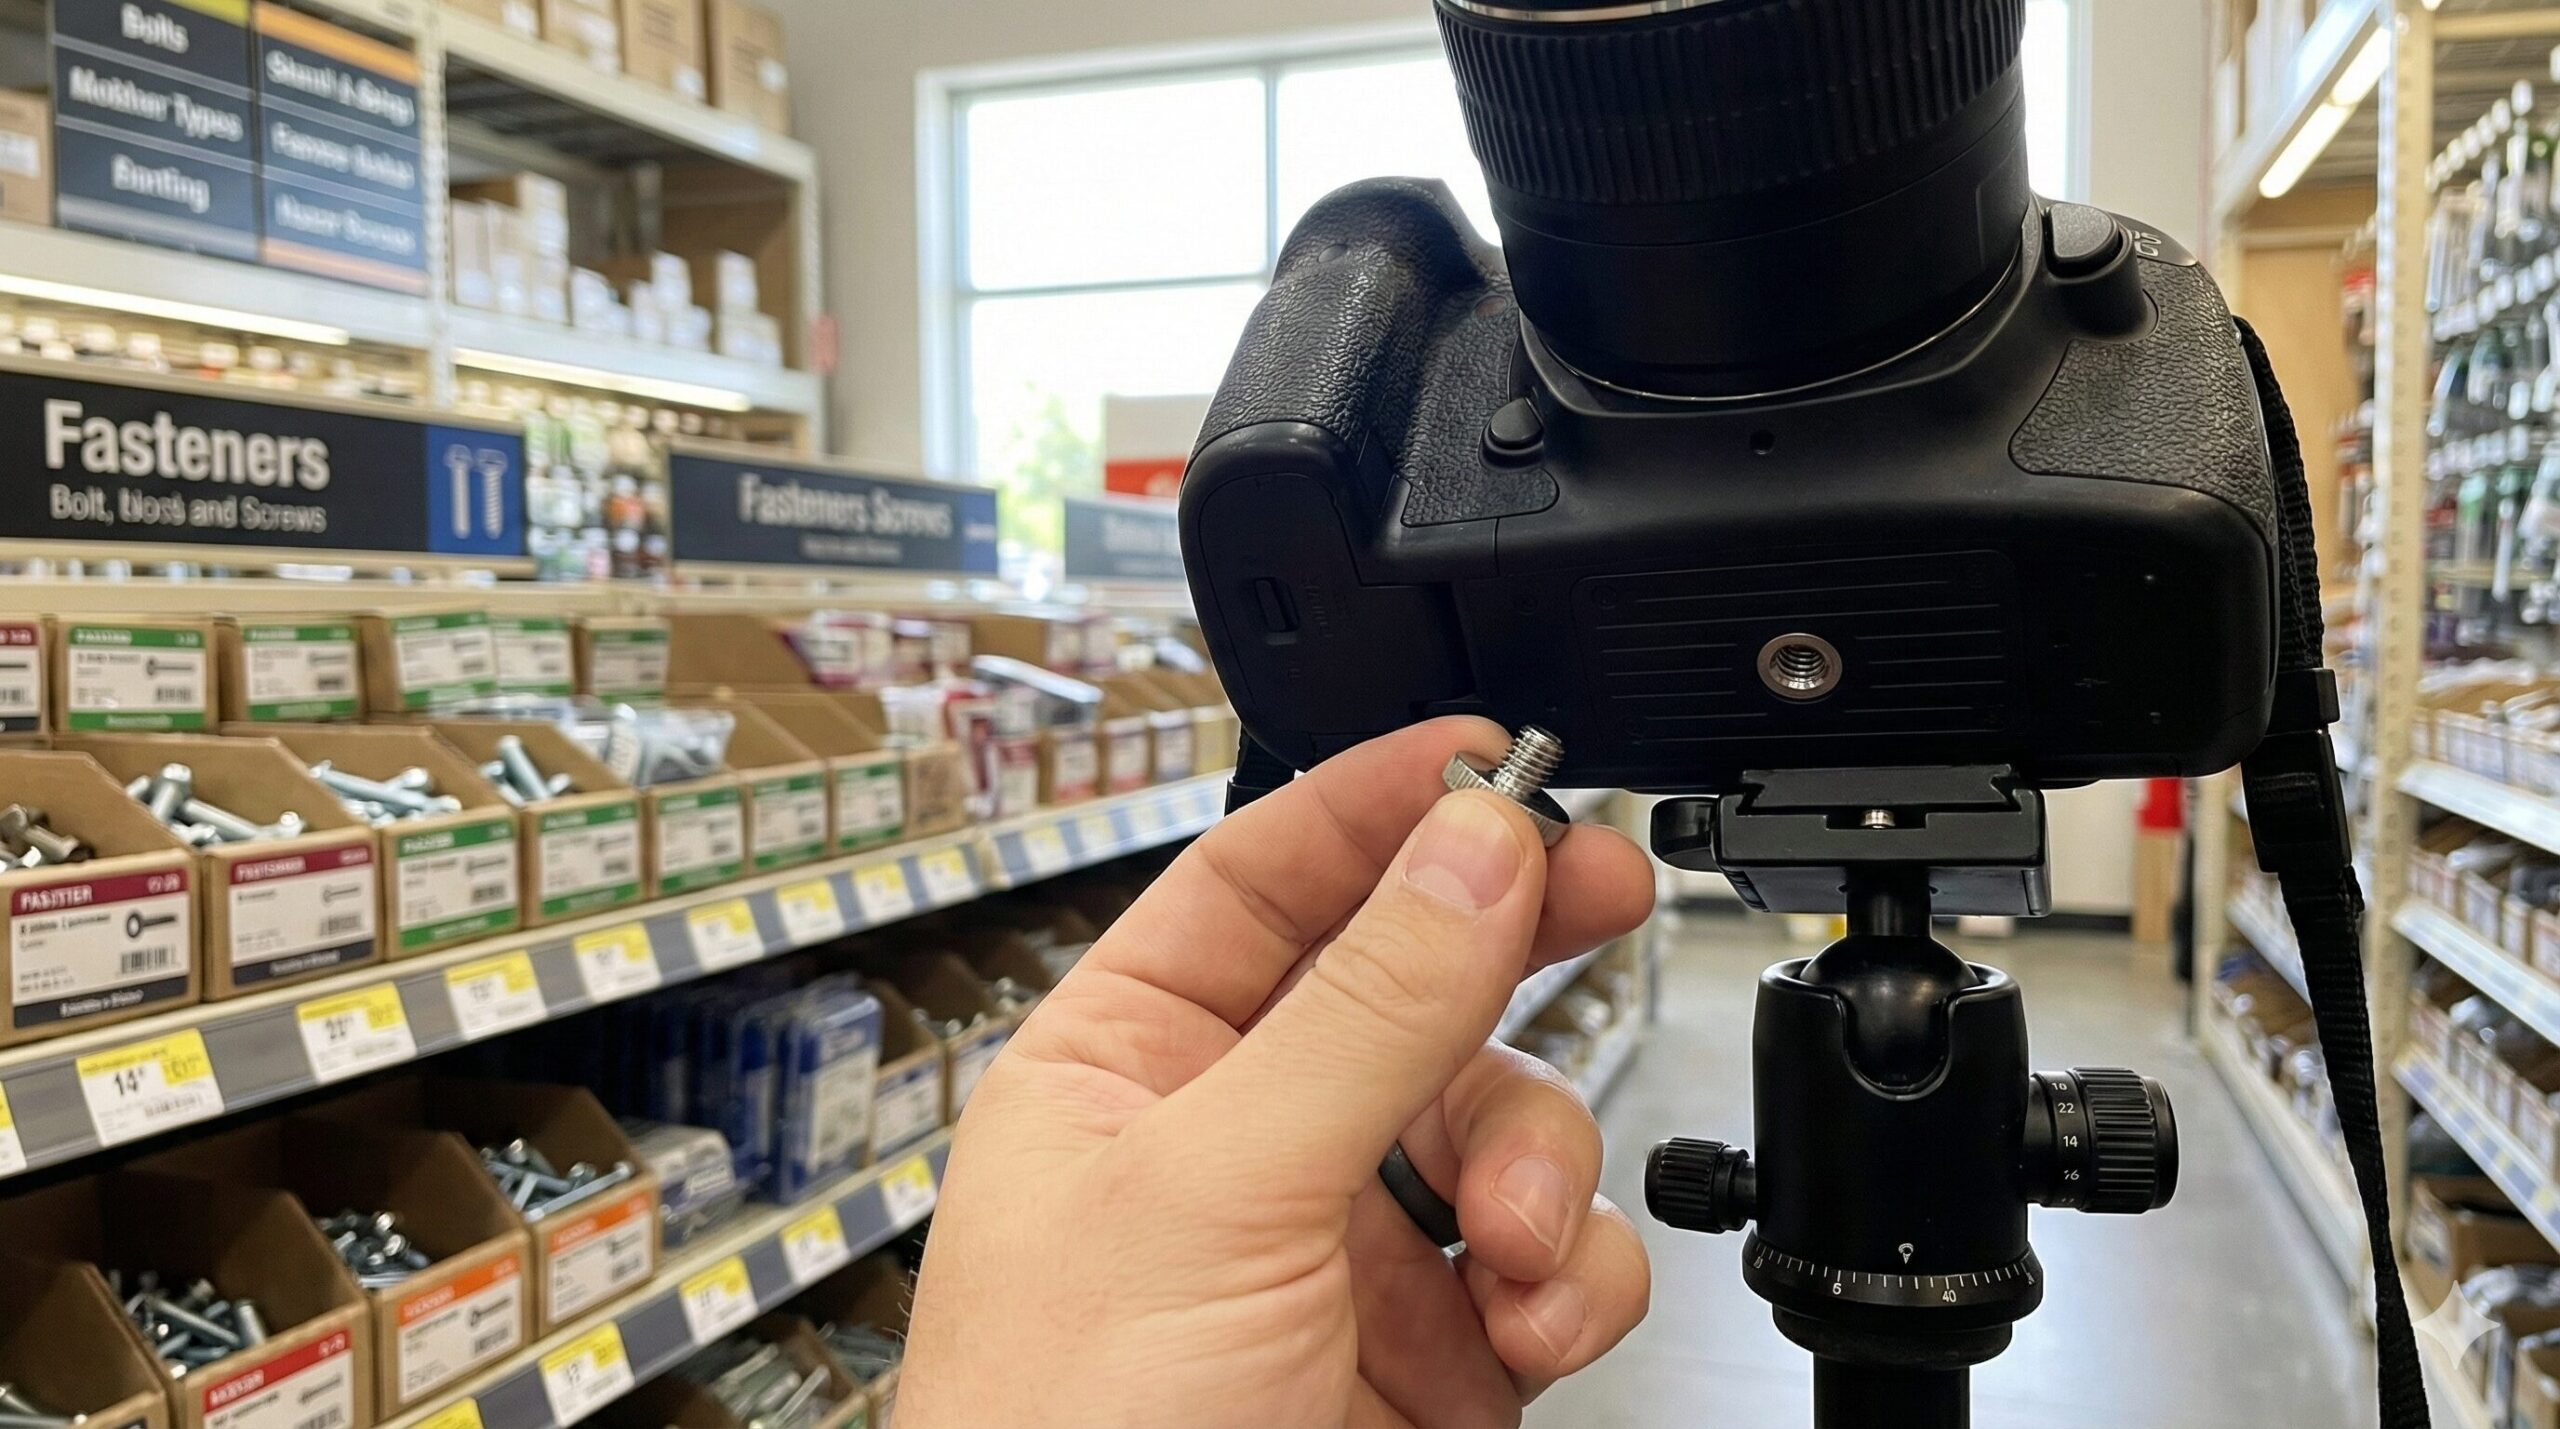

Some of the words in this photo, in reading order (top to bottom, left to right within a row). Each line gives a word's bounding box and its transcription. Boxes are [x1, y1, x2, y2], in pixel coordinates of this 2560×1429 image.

[44, 398, 330, 491] Fasteners
[2057, 1102, 2076, 1114] 22
[2063, 1135, 2079, 1148] 14
[1941, 1289, 1957, 1304] 40
